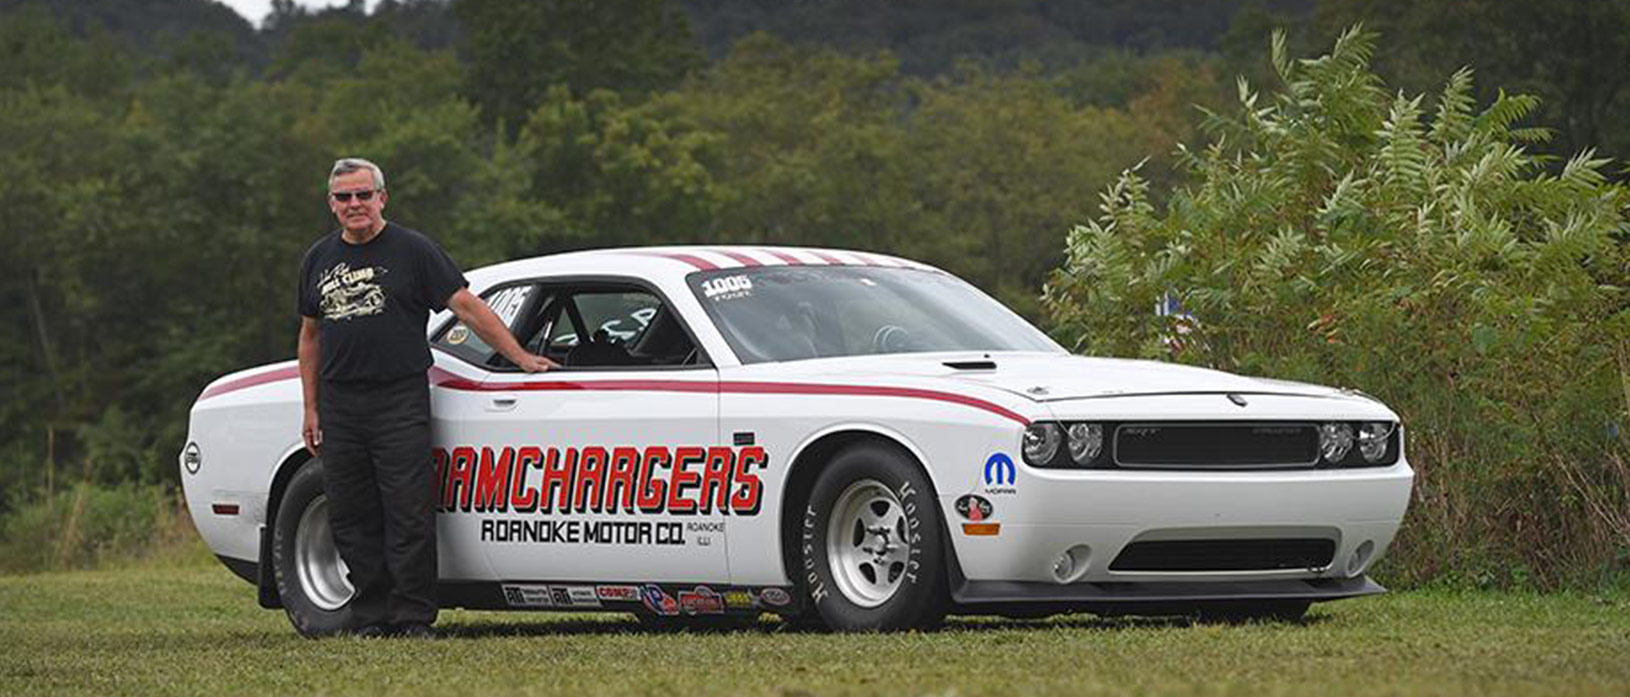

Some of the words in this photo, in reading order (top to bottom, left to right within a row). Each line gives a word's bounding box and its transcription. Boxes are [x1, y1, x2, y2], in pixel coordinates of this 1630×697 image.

[481, 519, 580, 542] ROANOKE
[583, 520, 652, 544] MOTOR
[655, 522, 686, 545] CO.
[686, 521, 725, 533] ROANOKE
